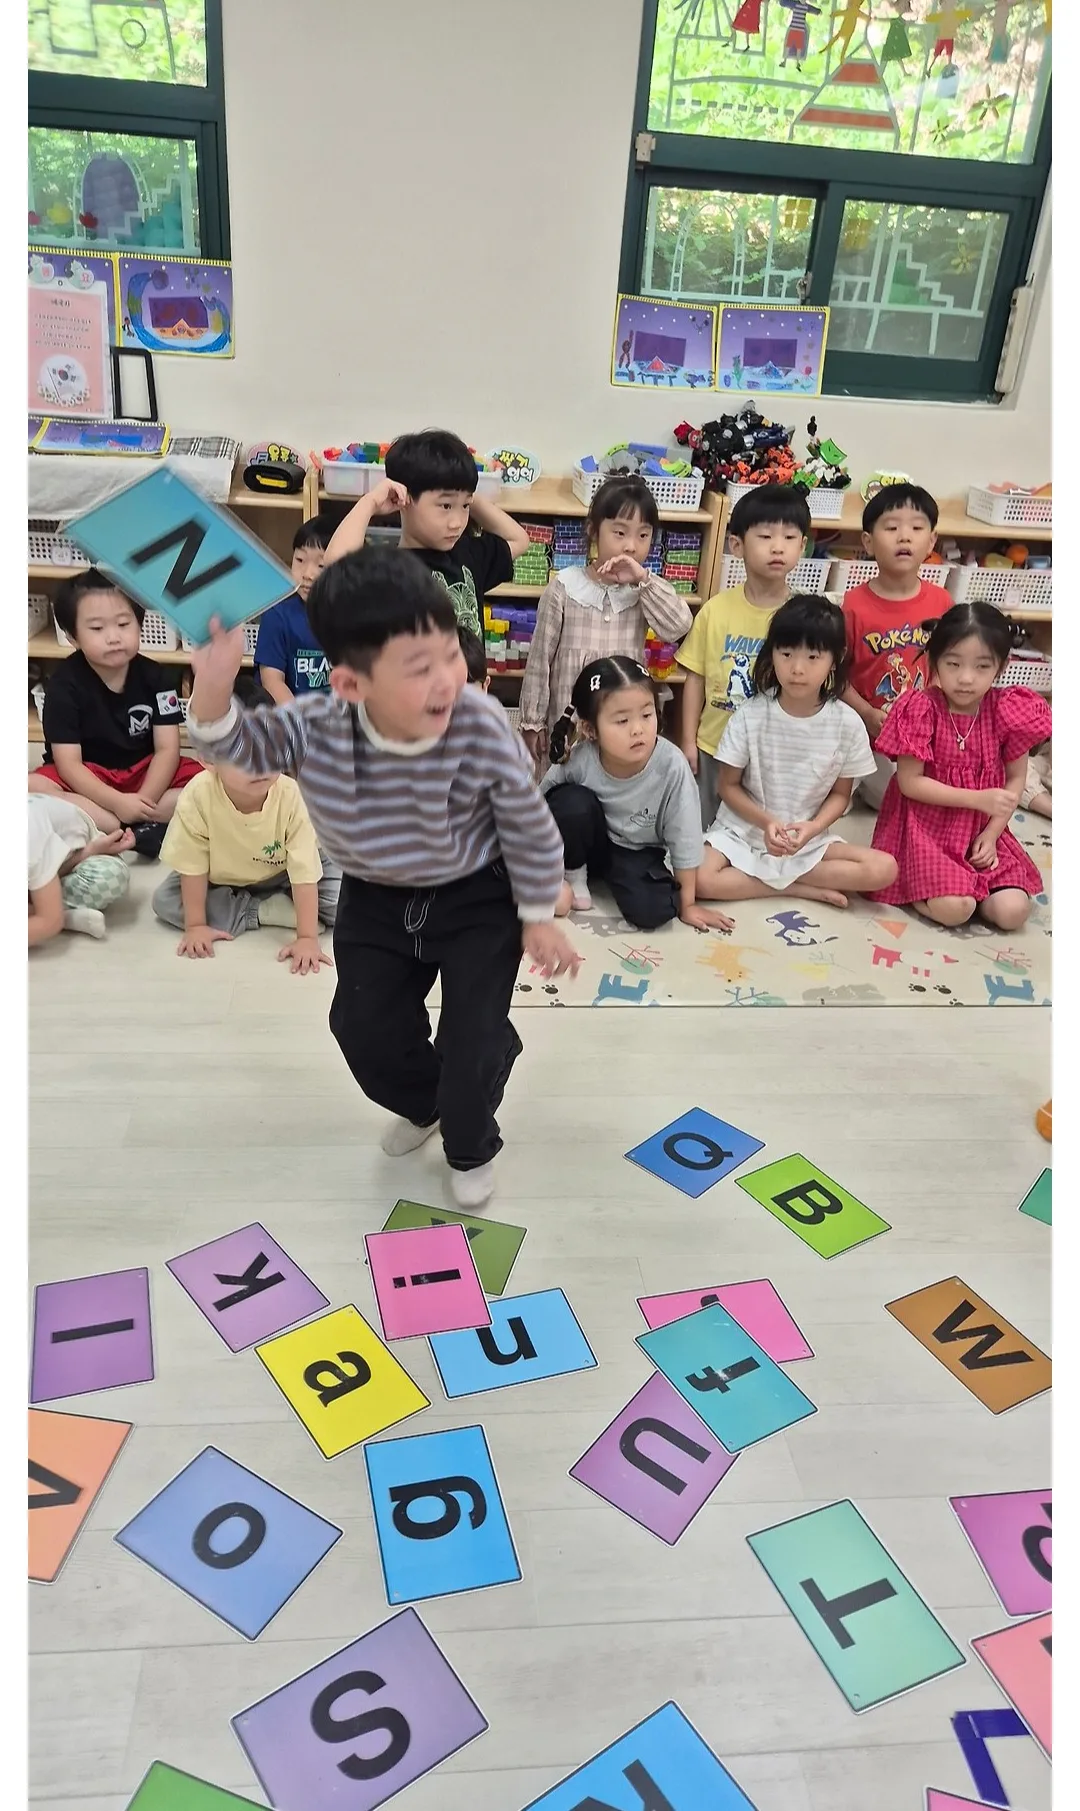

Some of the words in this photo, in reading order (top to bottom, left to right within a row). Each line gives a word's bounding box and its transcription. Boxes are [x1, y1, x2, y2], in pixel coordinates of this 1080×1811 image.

[129, 517, 242, 602] N
[663, 1131, 734, 1171] Q
[770, 1179, 843, 1225] B
[213, 1251, 286, 1312] k
[392, 1268, 462, 1289] i
[932, 1299, 1034, 1370] W
[304, 1350, 372, 1407] a
[685, 1356, 761, 1394] f
[619, 1417, 711, 1496] U
[389, 1475, 488, 1541] g
[800, 1577, 898, 1650] T
[311, 1670, 411, 1780] S
